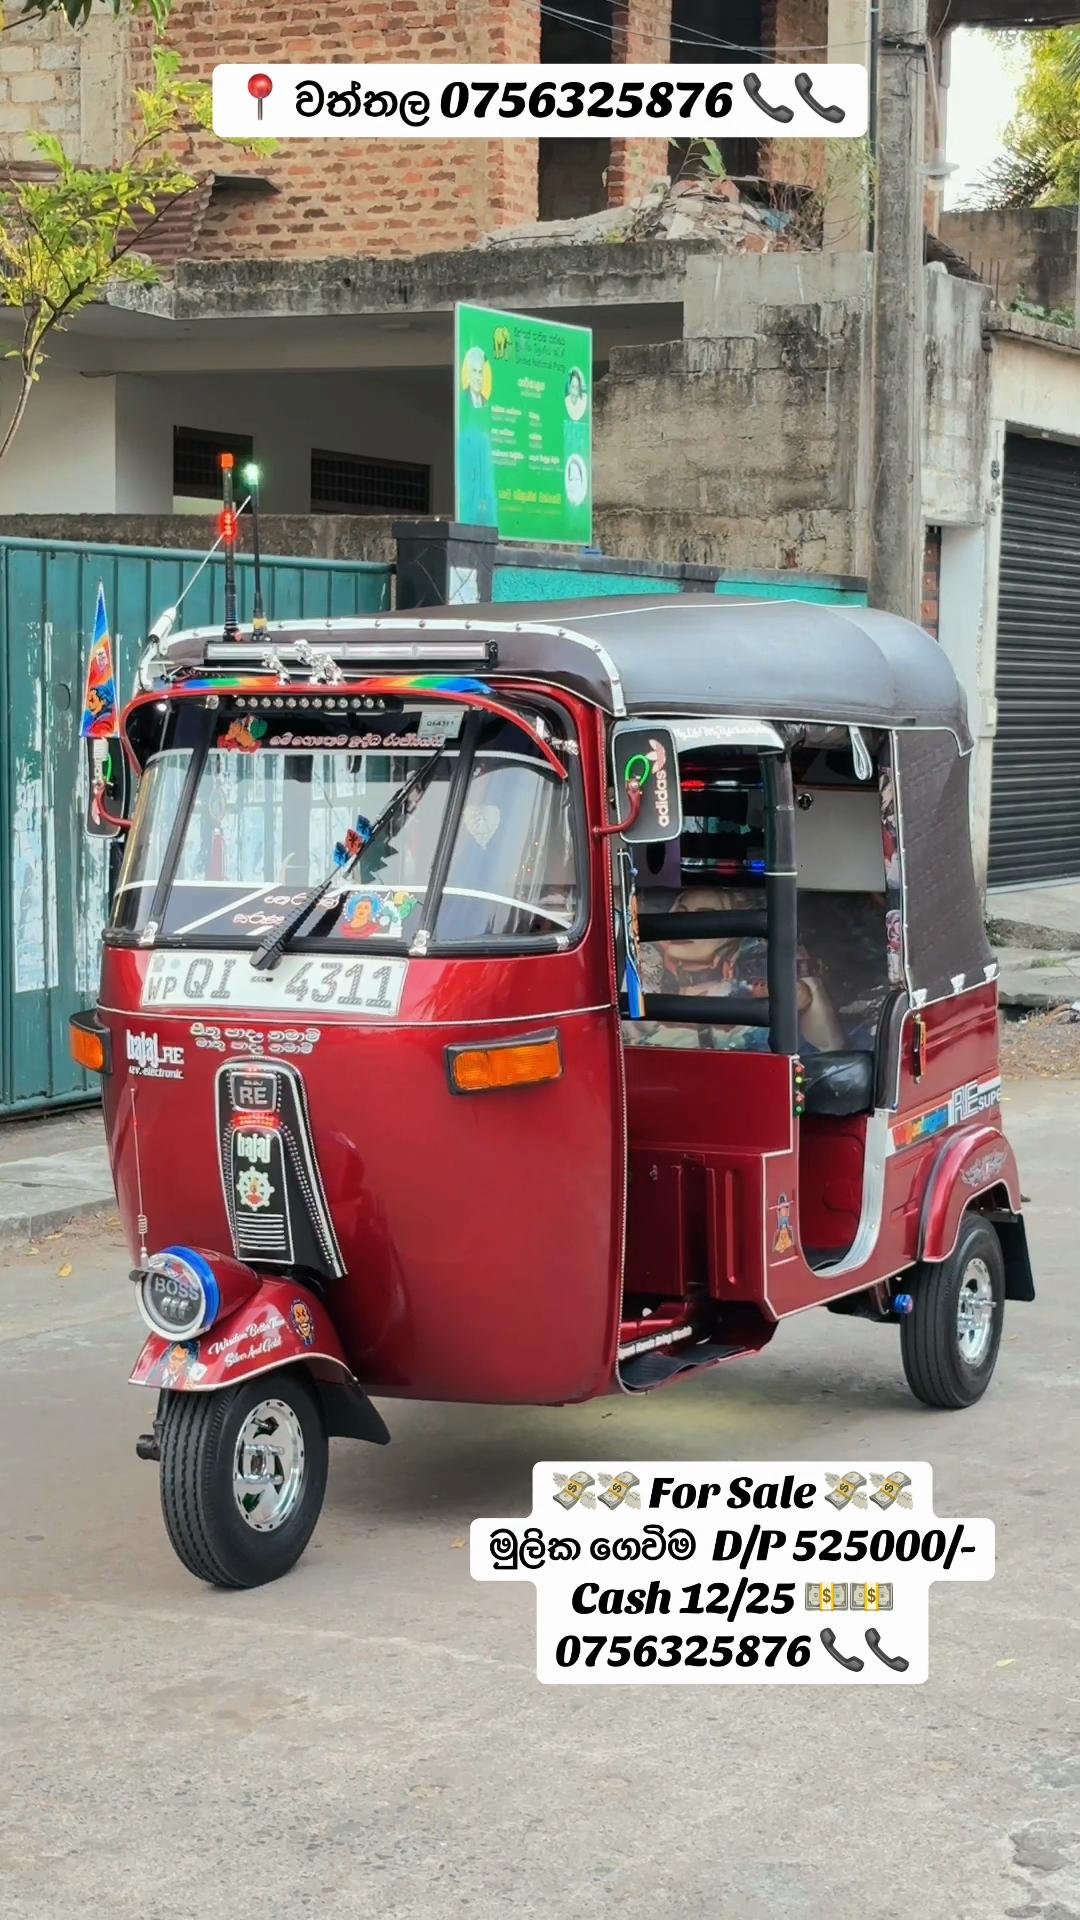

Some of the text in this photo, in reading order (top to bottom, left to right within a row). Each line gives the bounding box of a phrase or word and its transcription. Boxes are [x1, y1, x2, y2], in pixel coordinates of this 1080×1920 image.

[656, 769, 670, 827] adidas
[148, 974, 178, 1001] WP
[182, 958, 237, 1000] QI
[284, 961, 393, 1010] 4311
[126, 1029, 185, 1069] bajaj RE
[239, 1086, 269, 1105] RE
[952, 1079, 980, 1125] RE
[237, 1133, 271, 1164] bajaj
[154, 1276, 200, 1301] BOSS
